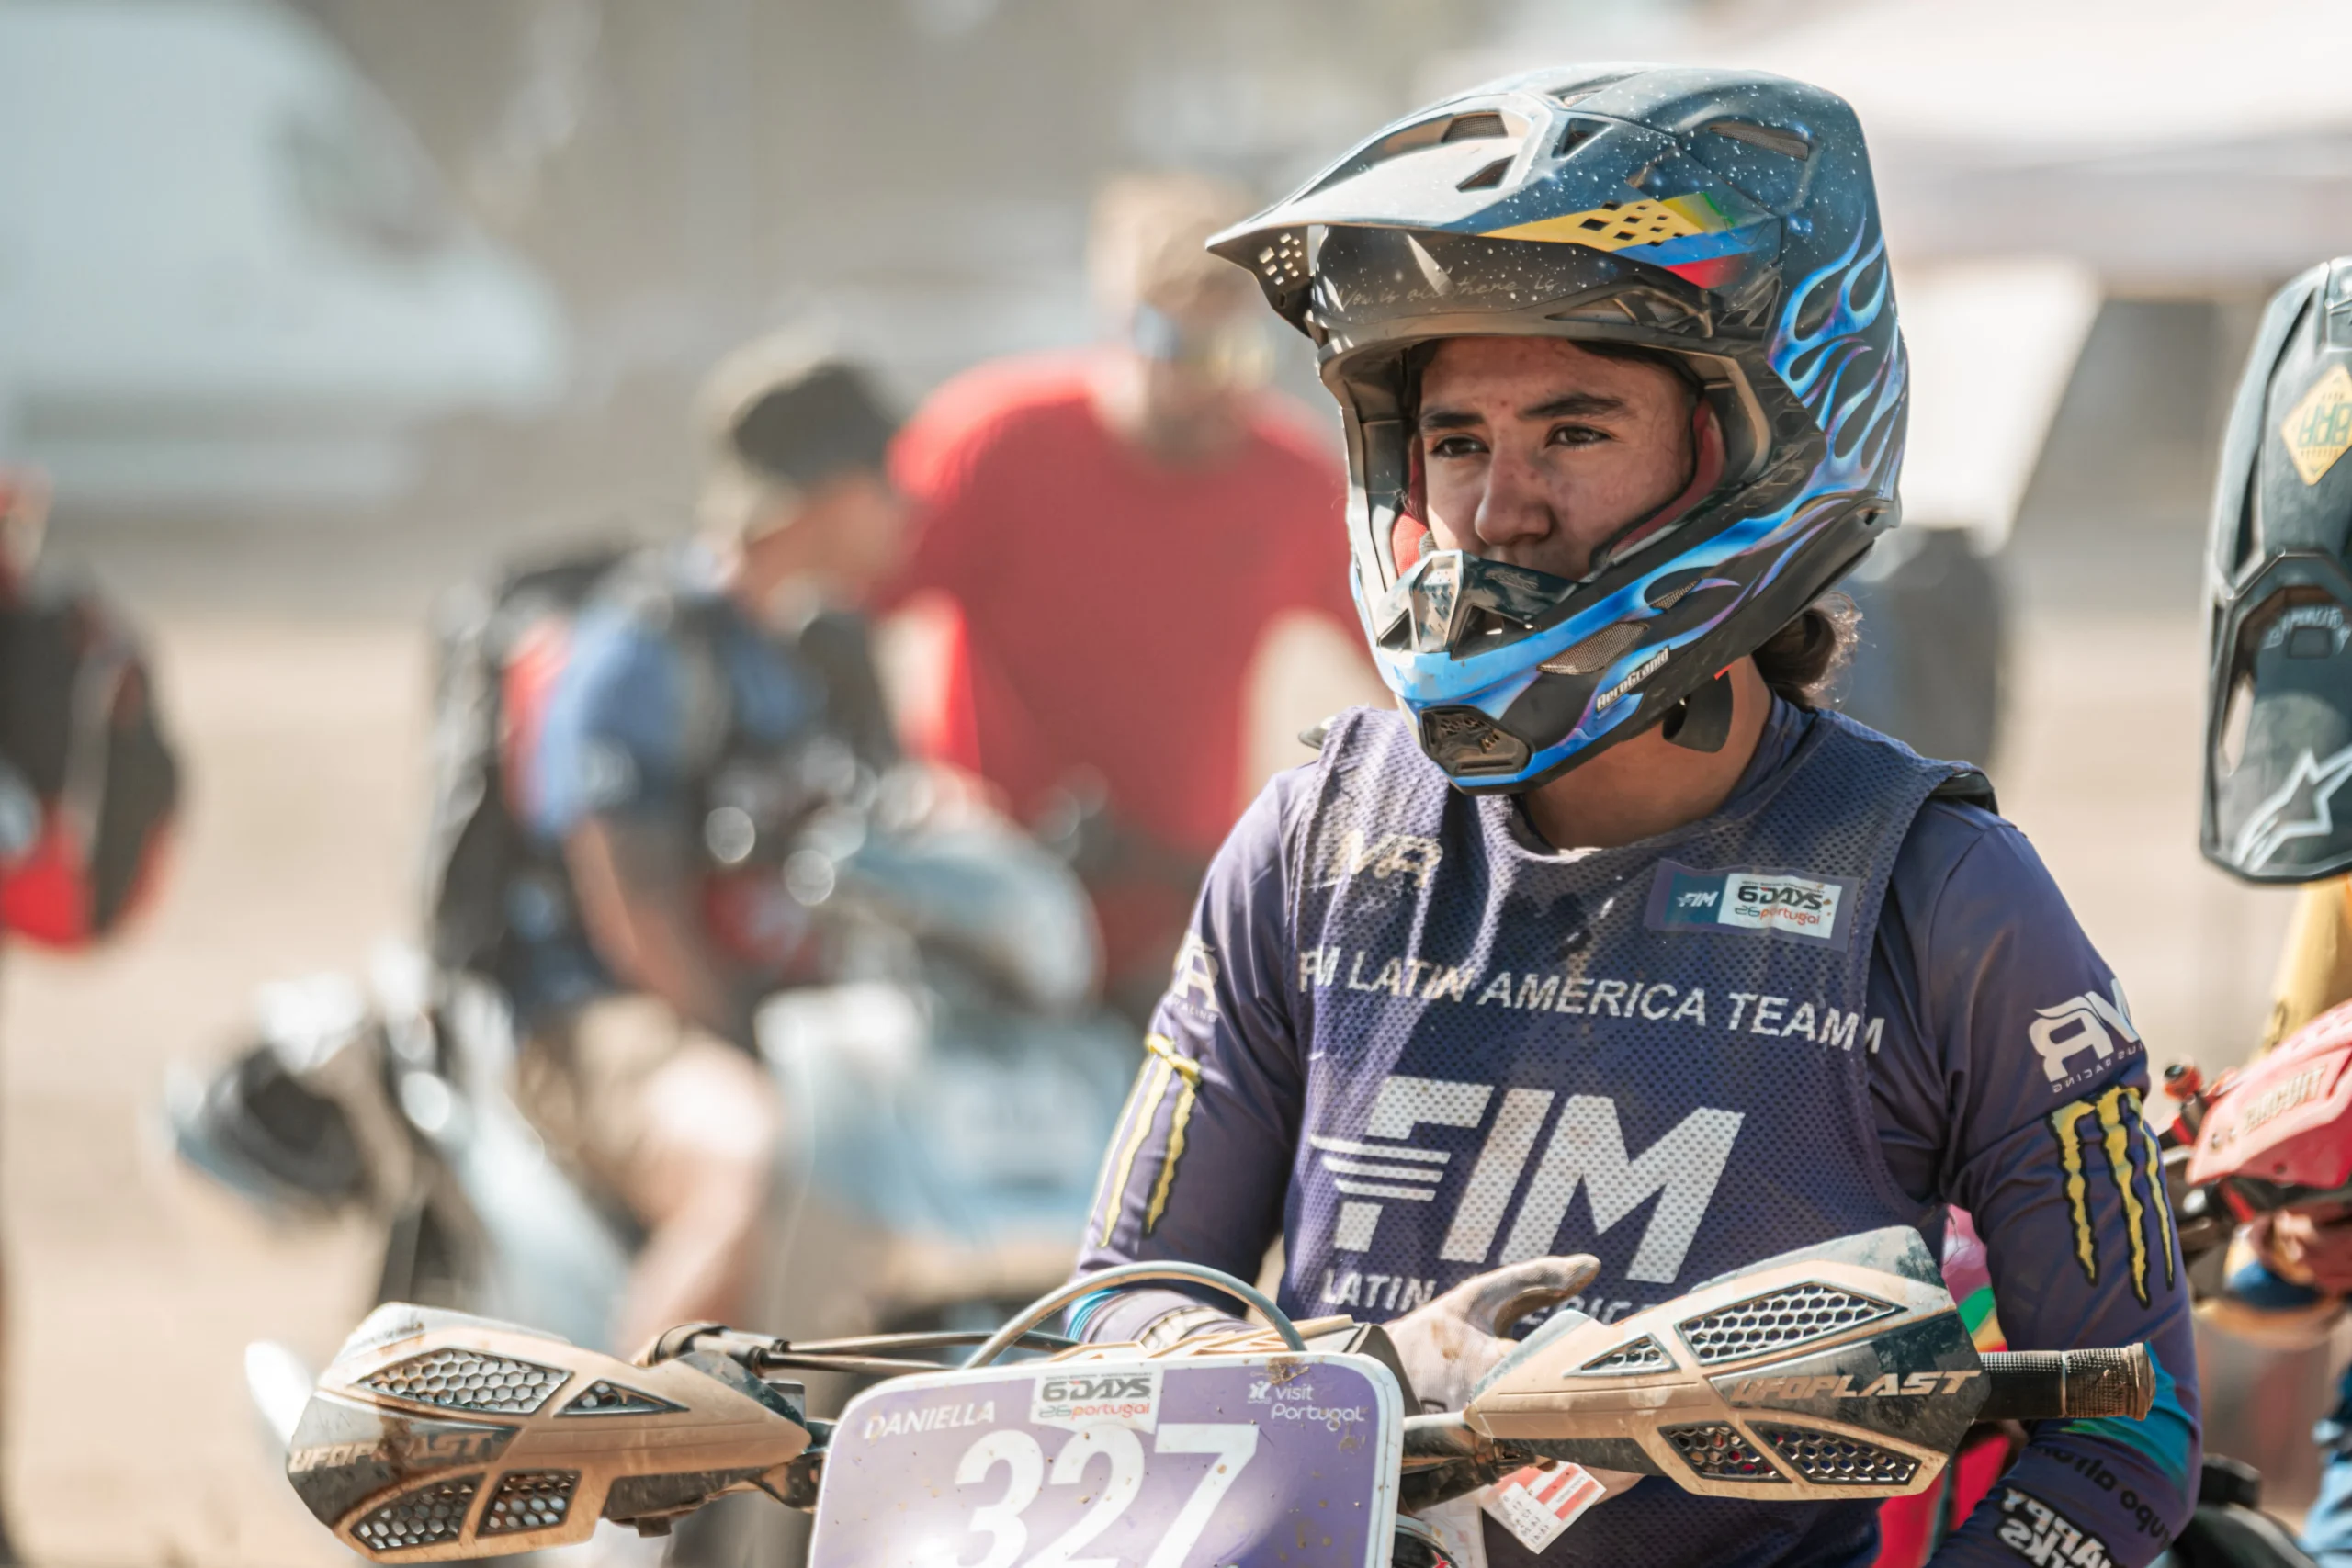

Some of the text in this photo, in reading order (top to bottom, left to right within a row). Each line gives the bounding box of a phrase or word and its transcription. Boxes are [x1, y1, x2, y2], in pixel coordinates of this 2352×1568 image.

[1737, 885, 1824, 911] 6DAYS
[1476, 971, 1706, 1026] AMERICA
[1728, 992, 1860, 1052] TEAM
[1309, 1076, 1746, 1285] FIM
[1321, 1269, 1437, 1312] LATIN
[1041, 1377, 1151, 1403] 6DAYS
[1275, 1383, 1314, 1401] visit
[863, 1400, 995, 1440] DANIELLA
[1271, 1403, 1365, 1433] Portugal
[954, 1422, 1261, 1568] 327
